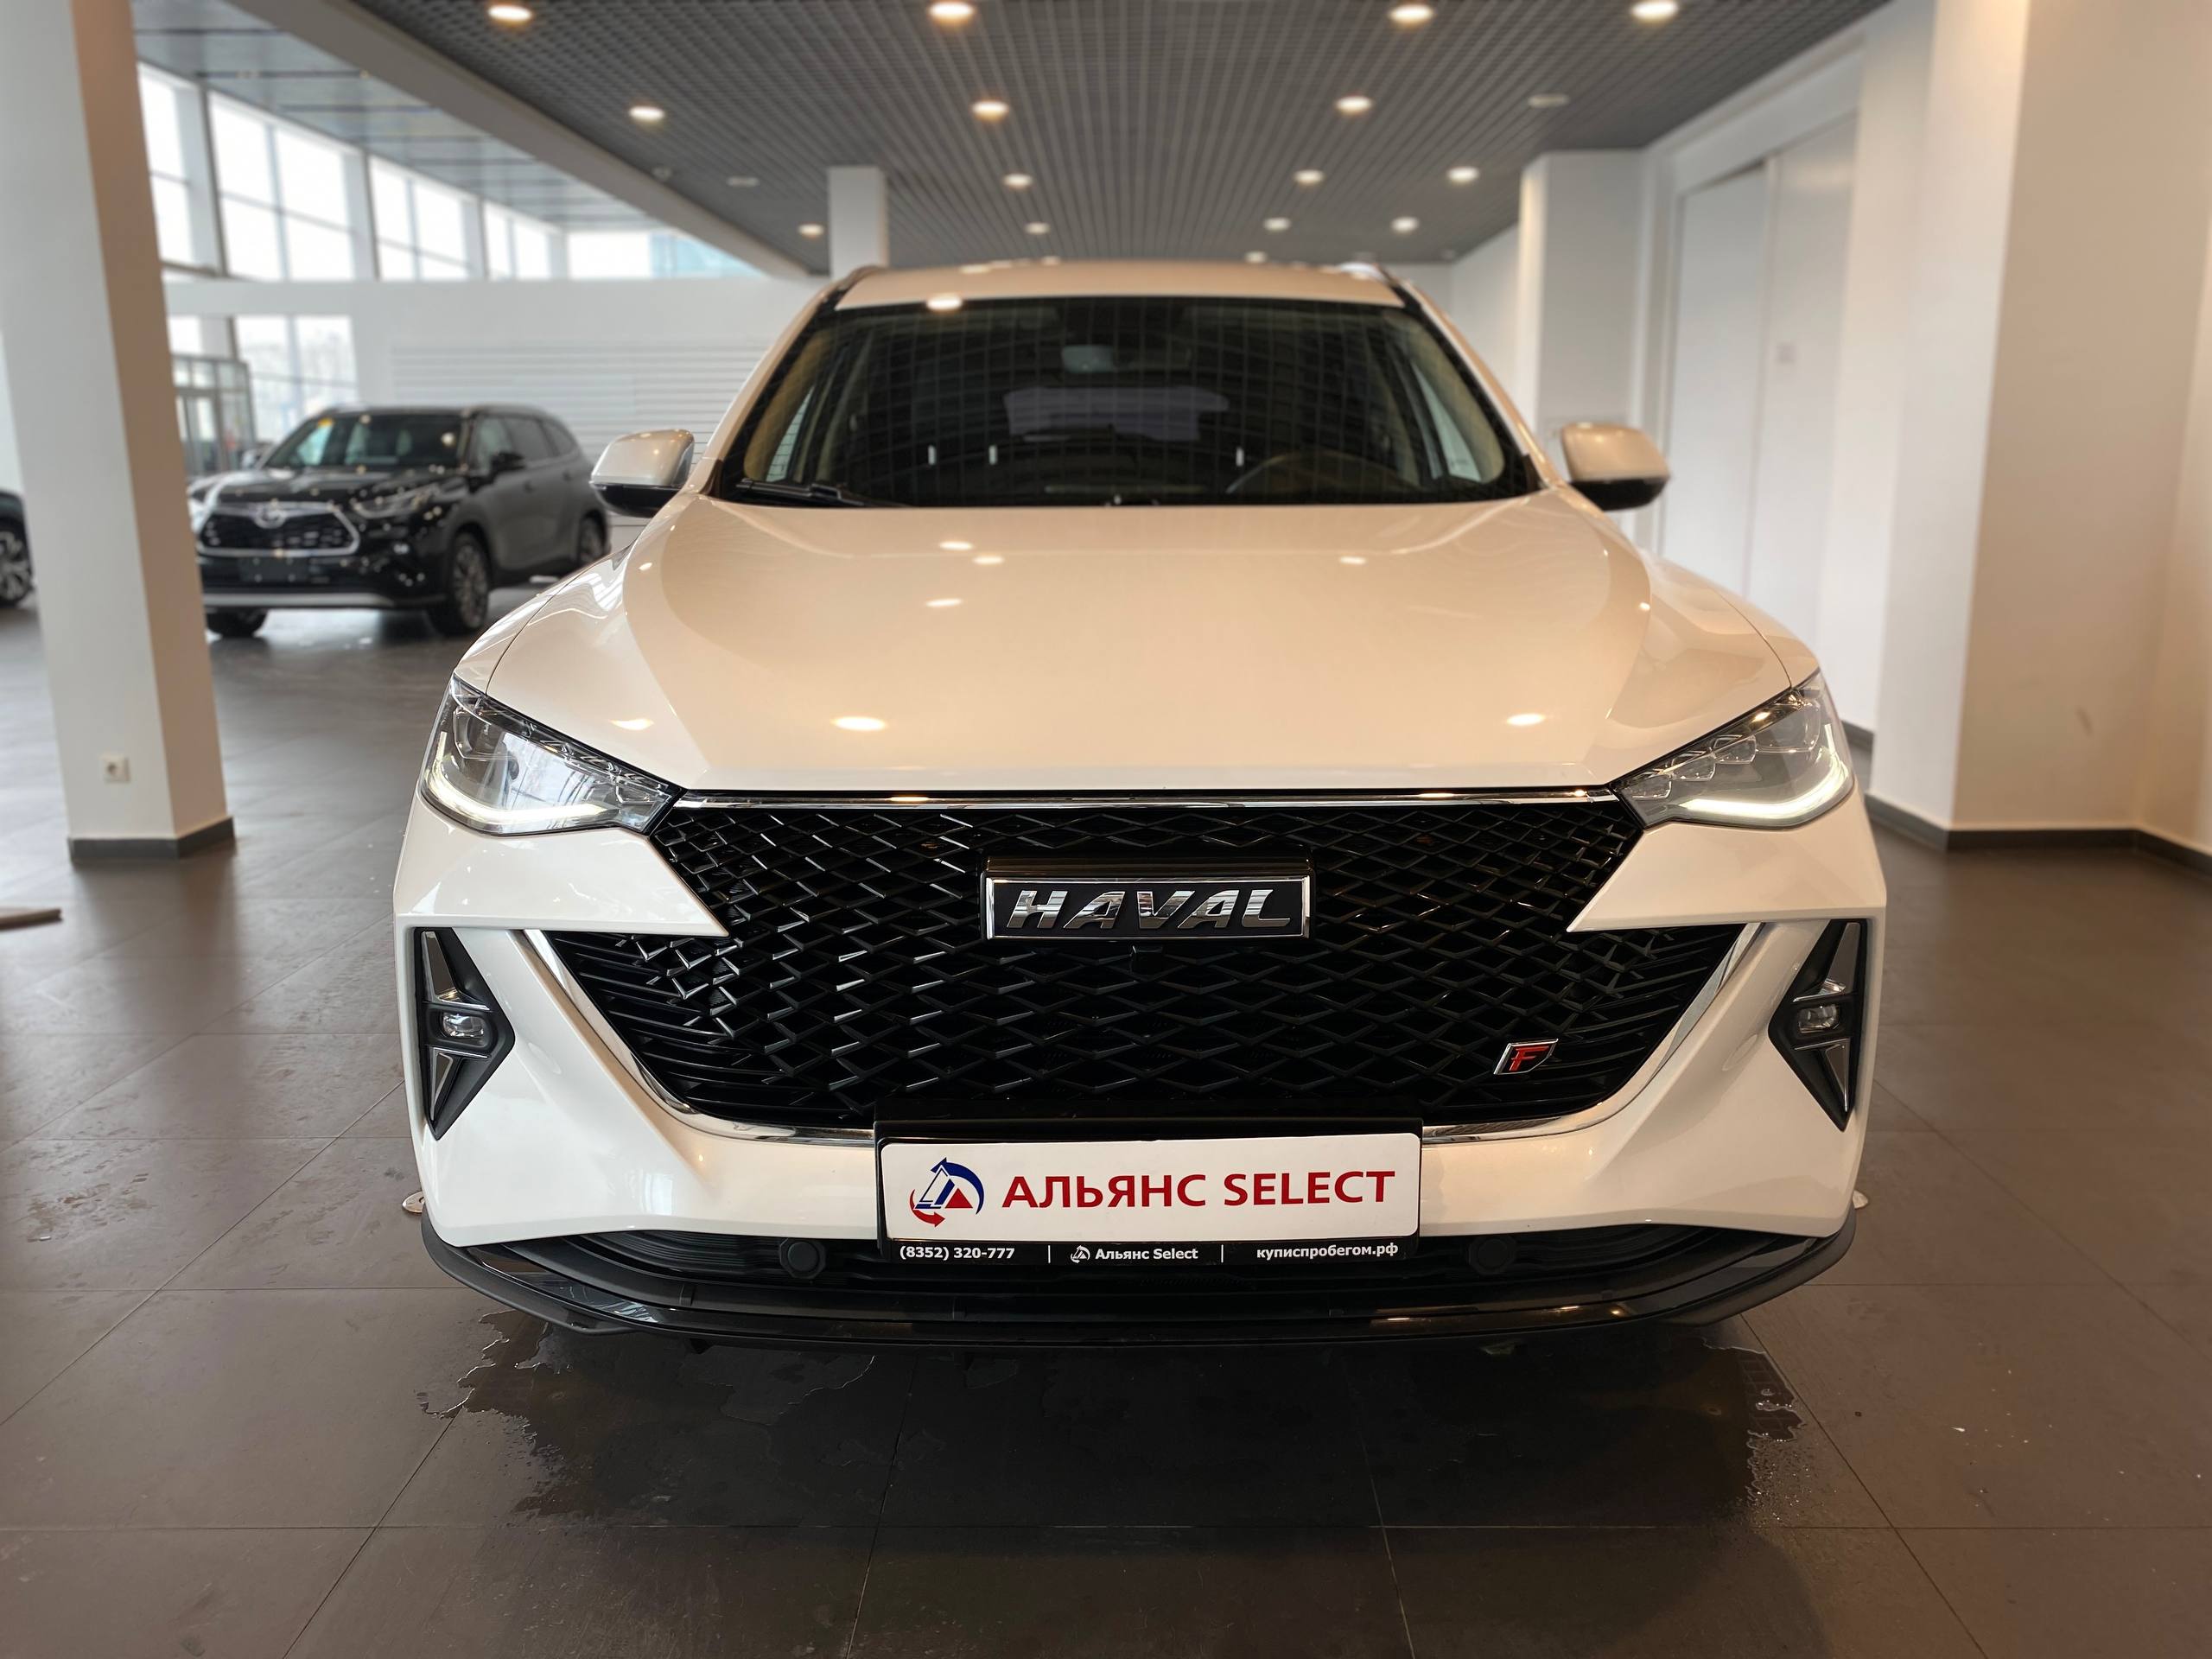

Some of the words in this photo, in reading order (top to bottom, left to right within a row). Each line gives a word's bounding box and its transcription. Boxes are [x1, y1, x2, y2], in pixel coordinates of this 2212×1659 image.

[1006, 888, 1291, 930] HAVAL
[1001, 1173, 1207, 1209] АЛЬЯНС
[1223, 1169, 1396, 1207] SELECT
[899, 1245, 950, 1261] (8352)
[953, 1247, 1015, 1259] 320-777
[1095, 1248, 1150, 1260] Альянс
[1153, 1248, 1198, 1260] Select
[1256, 1242, 1399, 1261] куписпробегом.рф
